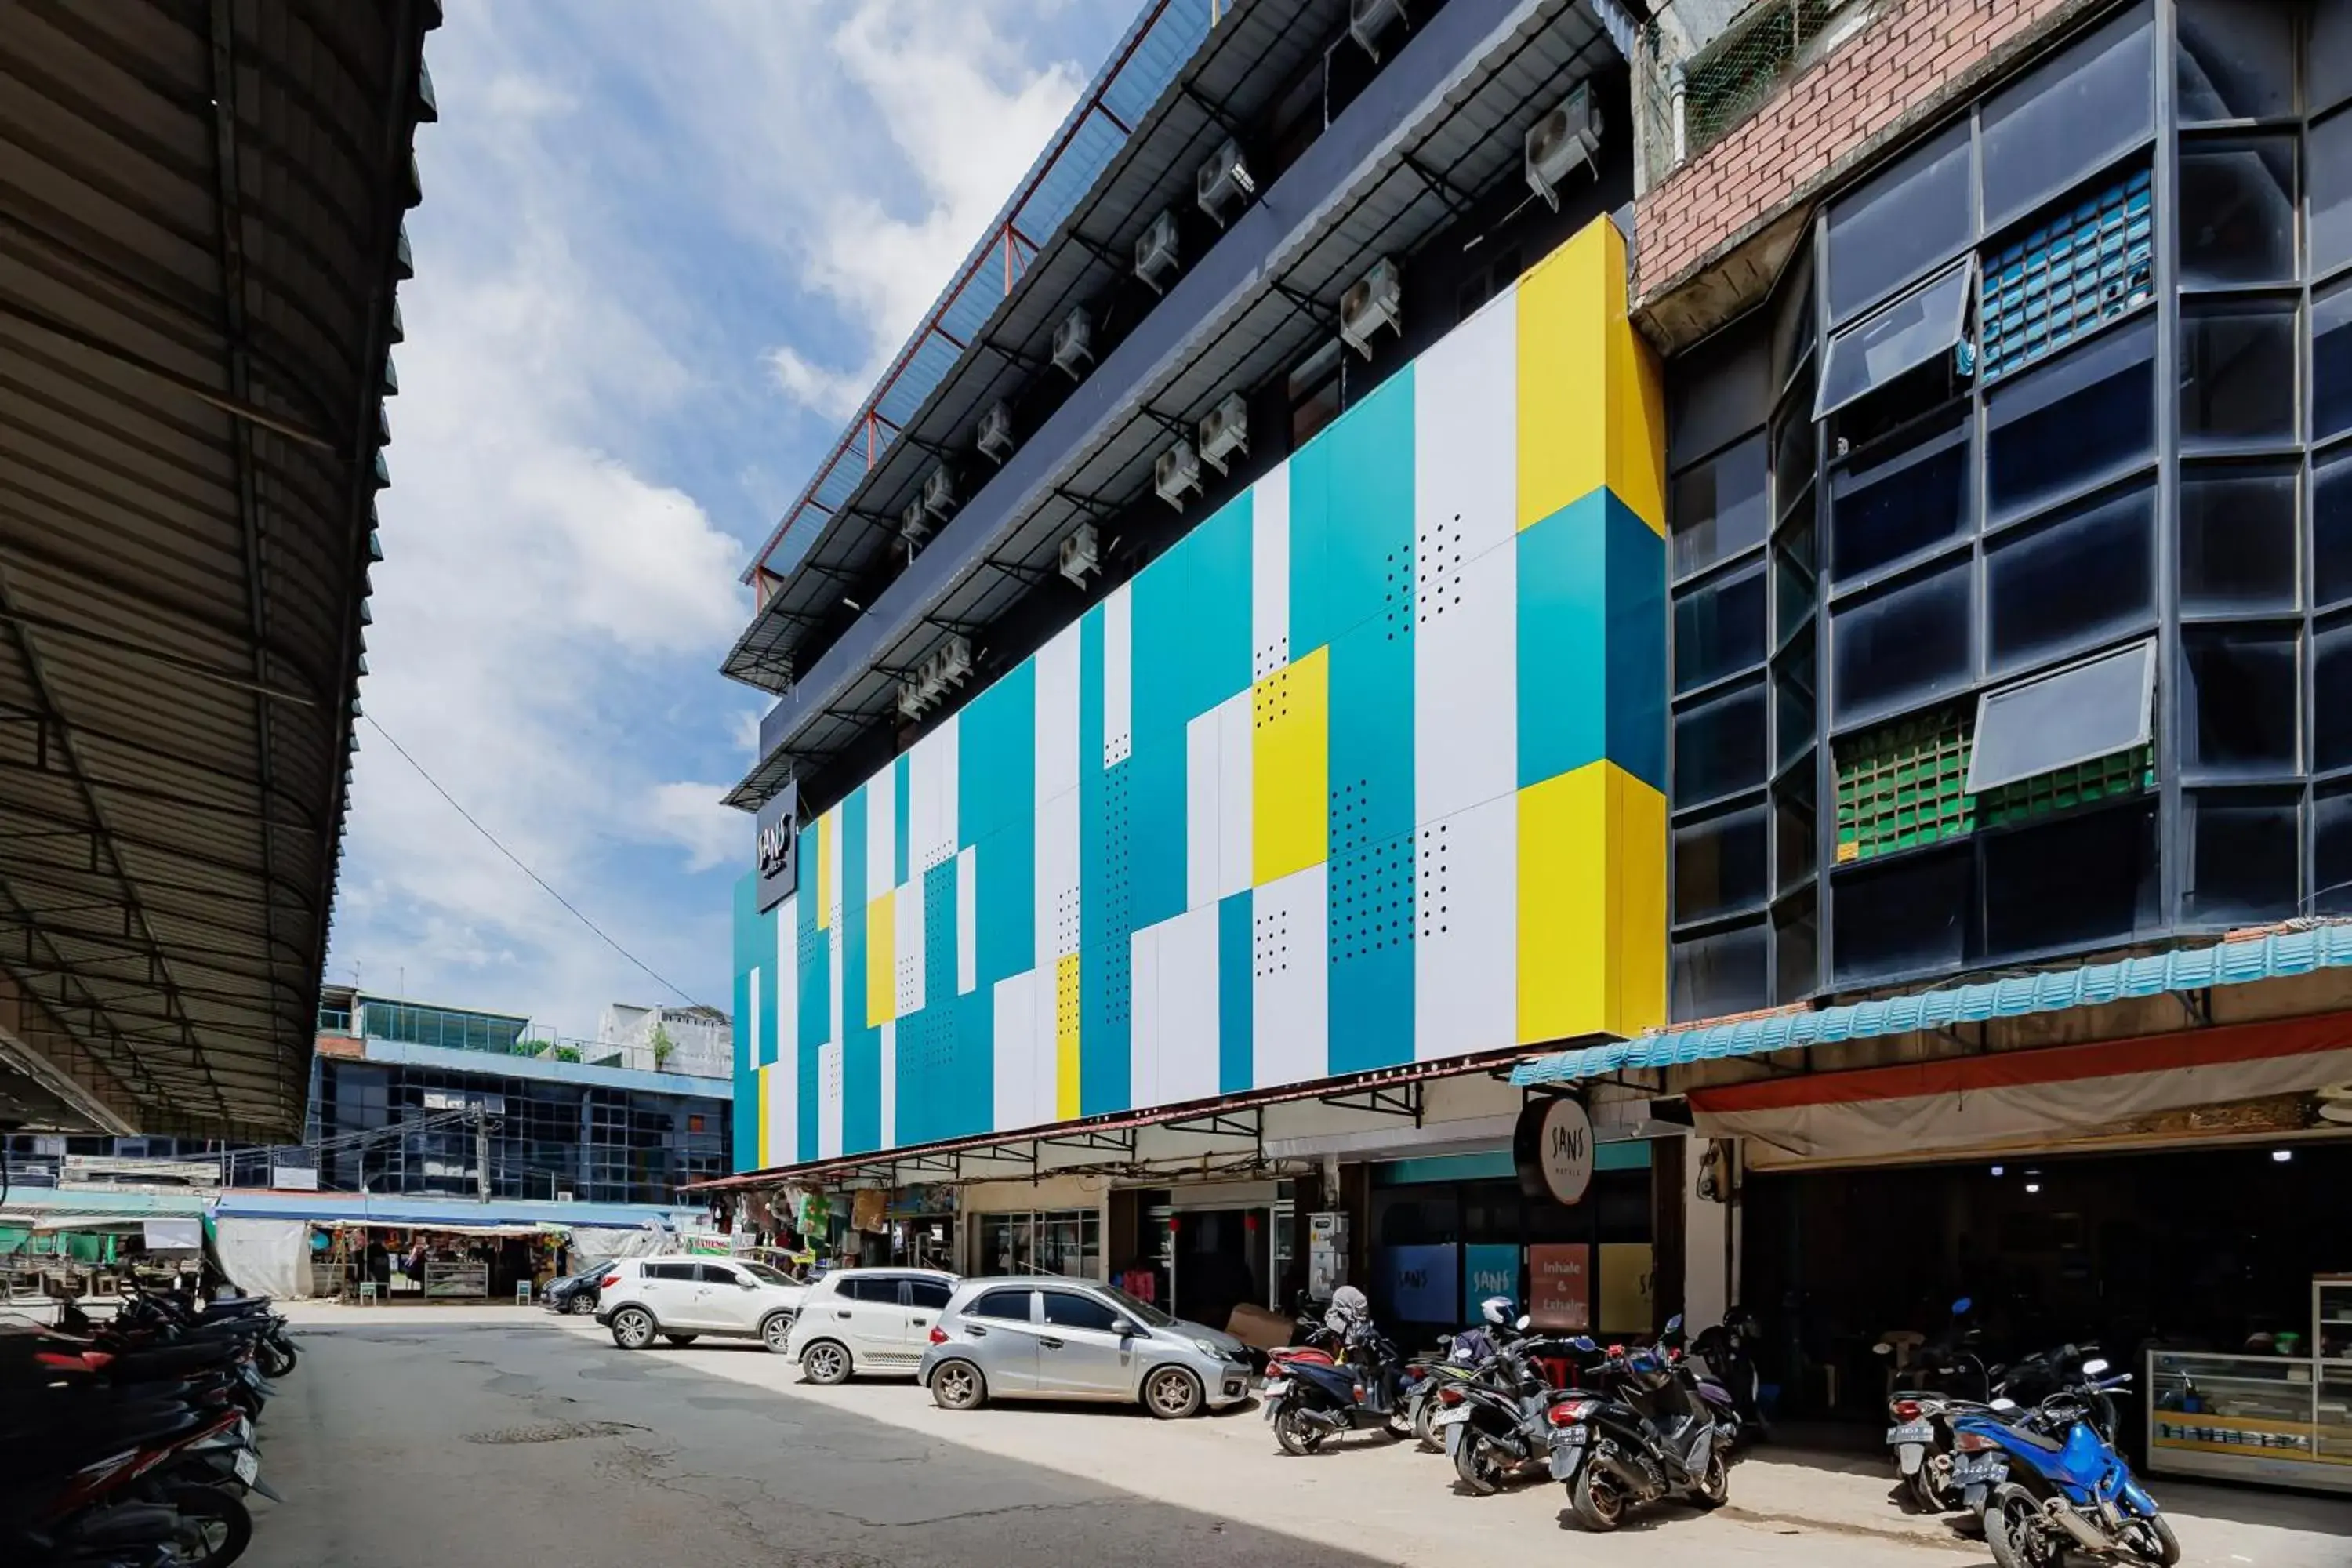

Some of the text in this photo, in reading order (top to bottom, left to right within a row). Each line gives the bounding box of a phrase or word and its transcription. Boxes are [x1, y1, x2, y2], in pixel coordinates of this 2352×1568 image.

[758, 812, 788, 871] SANS
[1552, 1126, 1583, 1161] SANS
[1543, 1261, 1581, 1275] Inhale
[1398, 1269, 1428, 1290] SANS
[1473, 1269, 1510, 1293] SANS
[1556, 1280, 1567, 1292] &
